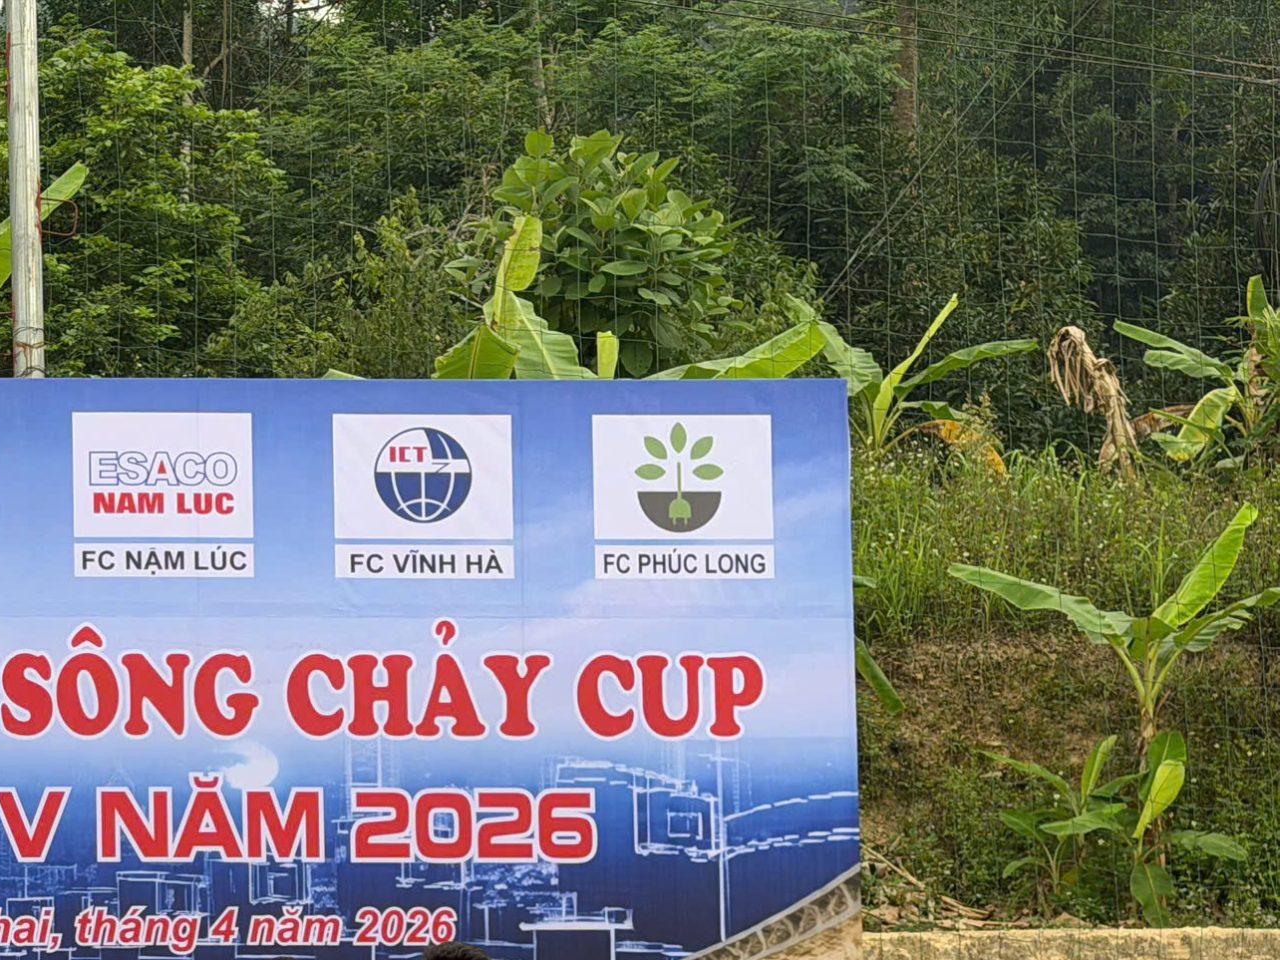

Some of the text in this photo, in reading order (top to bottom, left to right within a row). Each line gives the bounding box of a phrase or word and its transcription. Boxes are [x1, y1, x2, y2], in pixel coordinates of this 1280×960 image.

[389, 447, 425, 463] ICT
[89, 451, 238, 486] ESACO
[93, 492, 234, 516] NAM LUC
[82, 550, 115, 571] FC
[194, 545, 247, 571] LÚC
[350, 549, 504, 574] FC VĨNH HÀ
[603, 548, 766, 574] FC PHÚC LONG
[1, 626, 260, 737] SÔNG
[287, 621, 551, 737] CHẢY
[577, 655, 764, 738] CUP
[100, 778, 321, 859] NĂM
[354, 792, 594, 860] 2026
[73, 904, 201, 955] tháng
[209, 907, 238, 945] 4
[246, 905, 343, 946] năm
[353, 905, 458, 946] 2026
